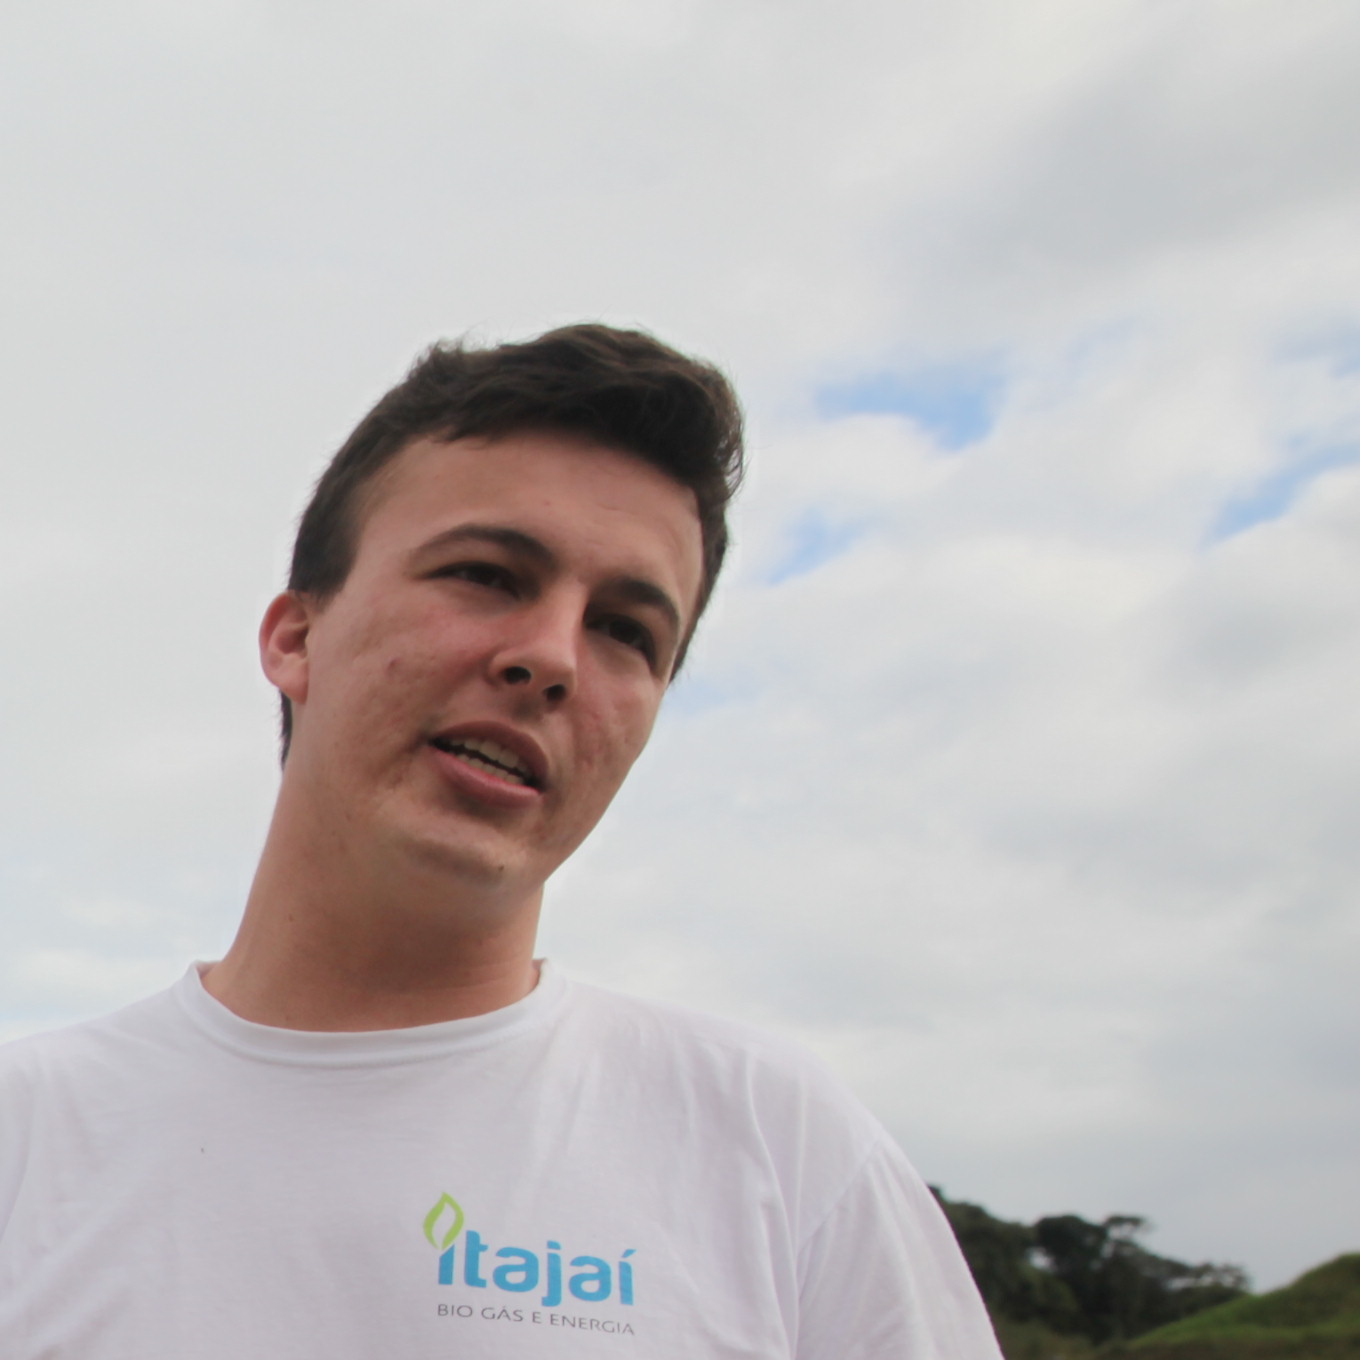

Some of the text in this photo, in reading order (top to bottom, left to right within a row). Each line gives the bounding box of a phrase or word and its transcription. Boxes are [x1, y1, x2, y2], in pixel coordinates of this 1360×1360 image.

[437, 1304, 473, 1317] BIO
[532, 1311, 542, 1324] E
[550, 1314, 635, 1335] ENERGIA
